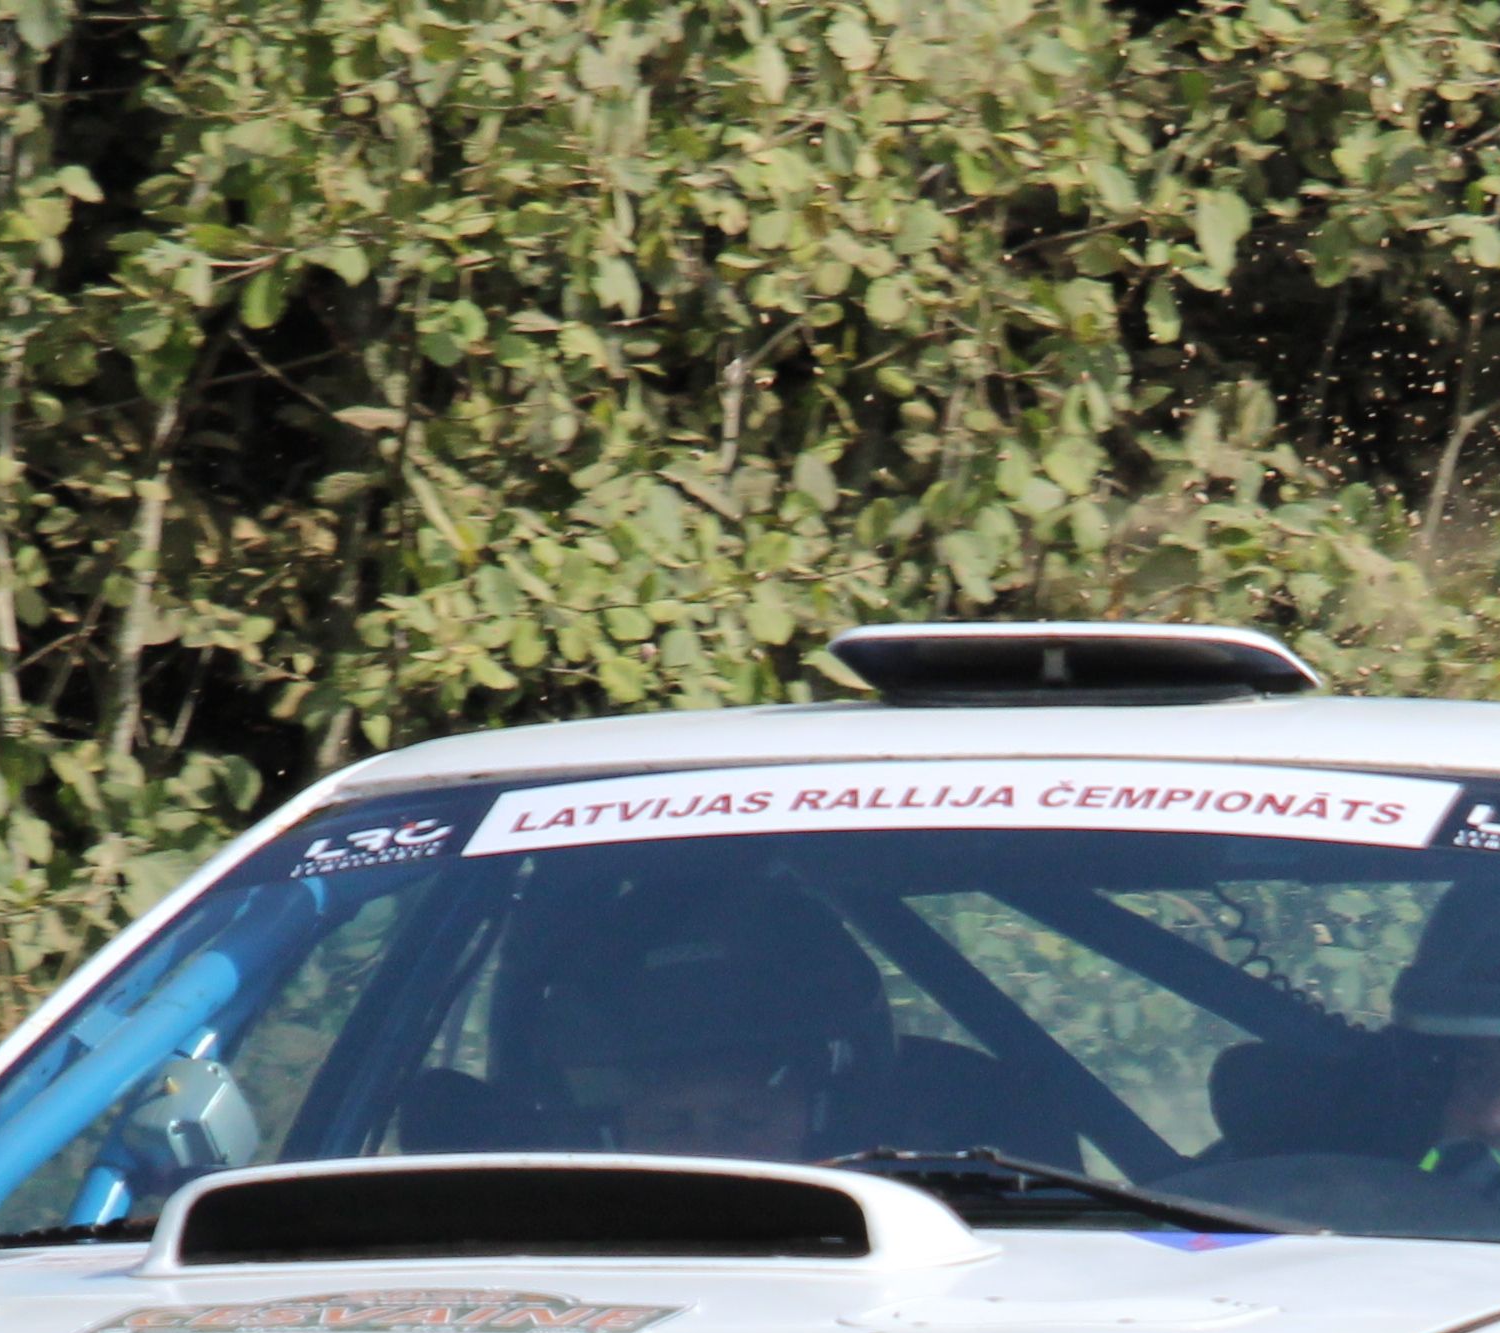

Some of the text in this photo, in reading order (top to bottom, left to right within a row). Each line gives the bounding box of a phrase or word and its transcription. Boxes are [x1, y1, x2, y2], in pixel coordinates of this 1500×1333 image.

[510, 780, 1408, 834] LATVIJAS RALLIJA ČEMPIONĀTS
